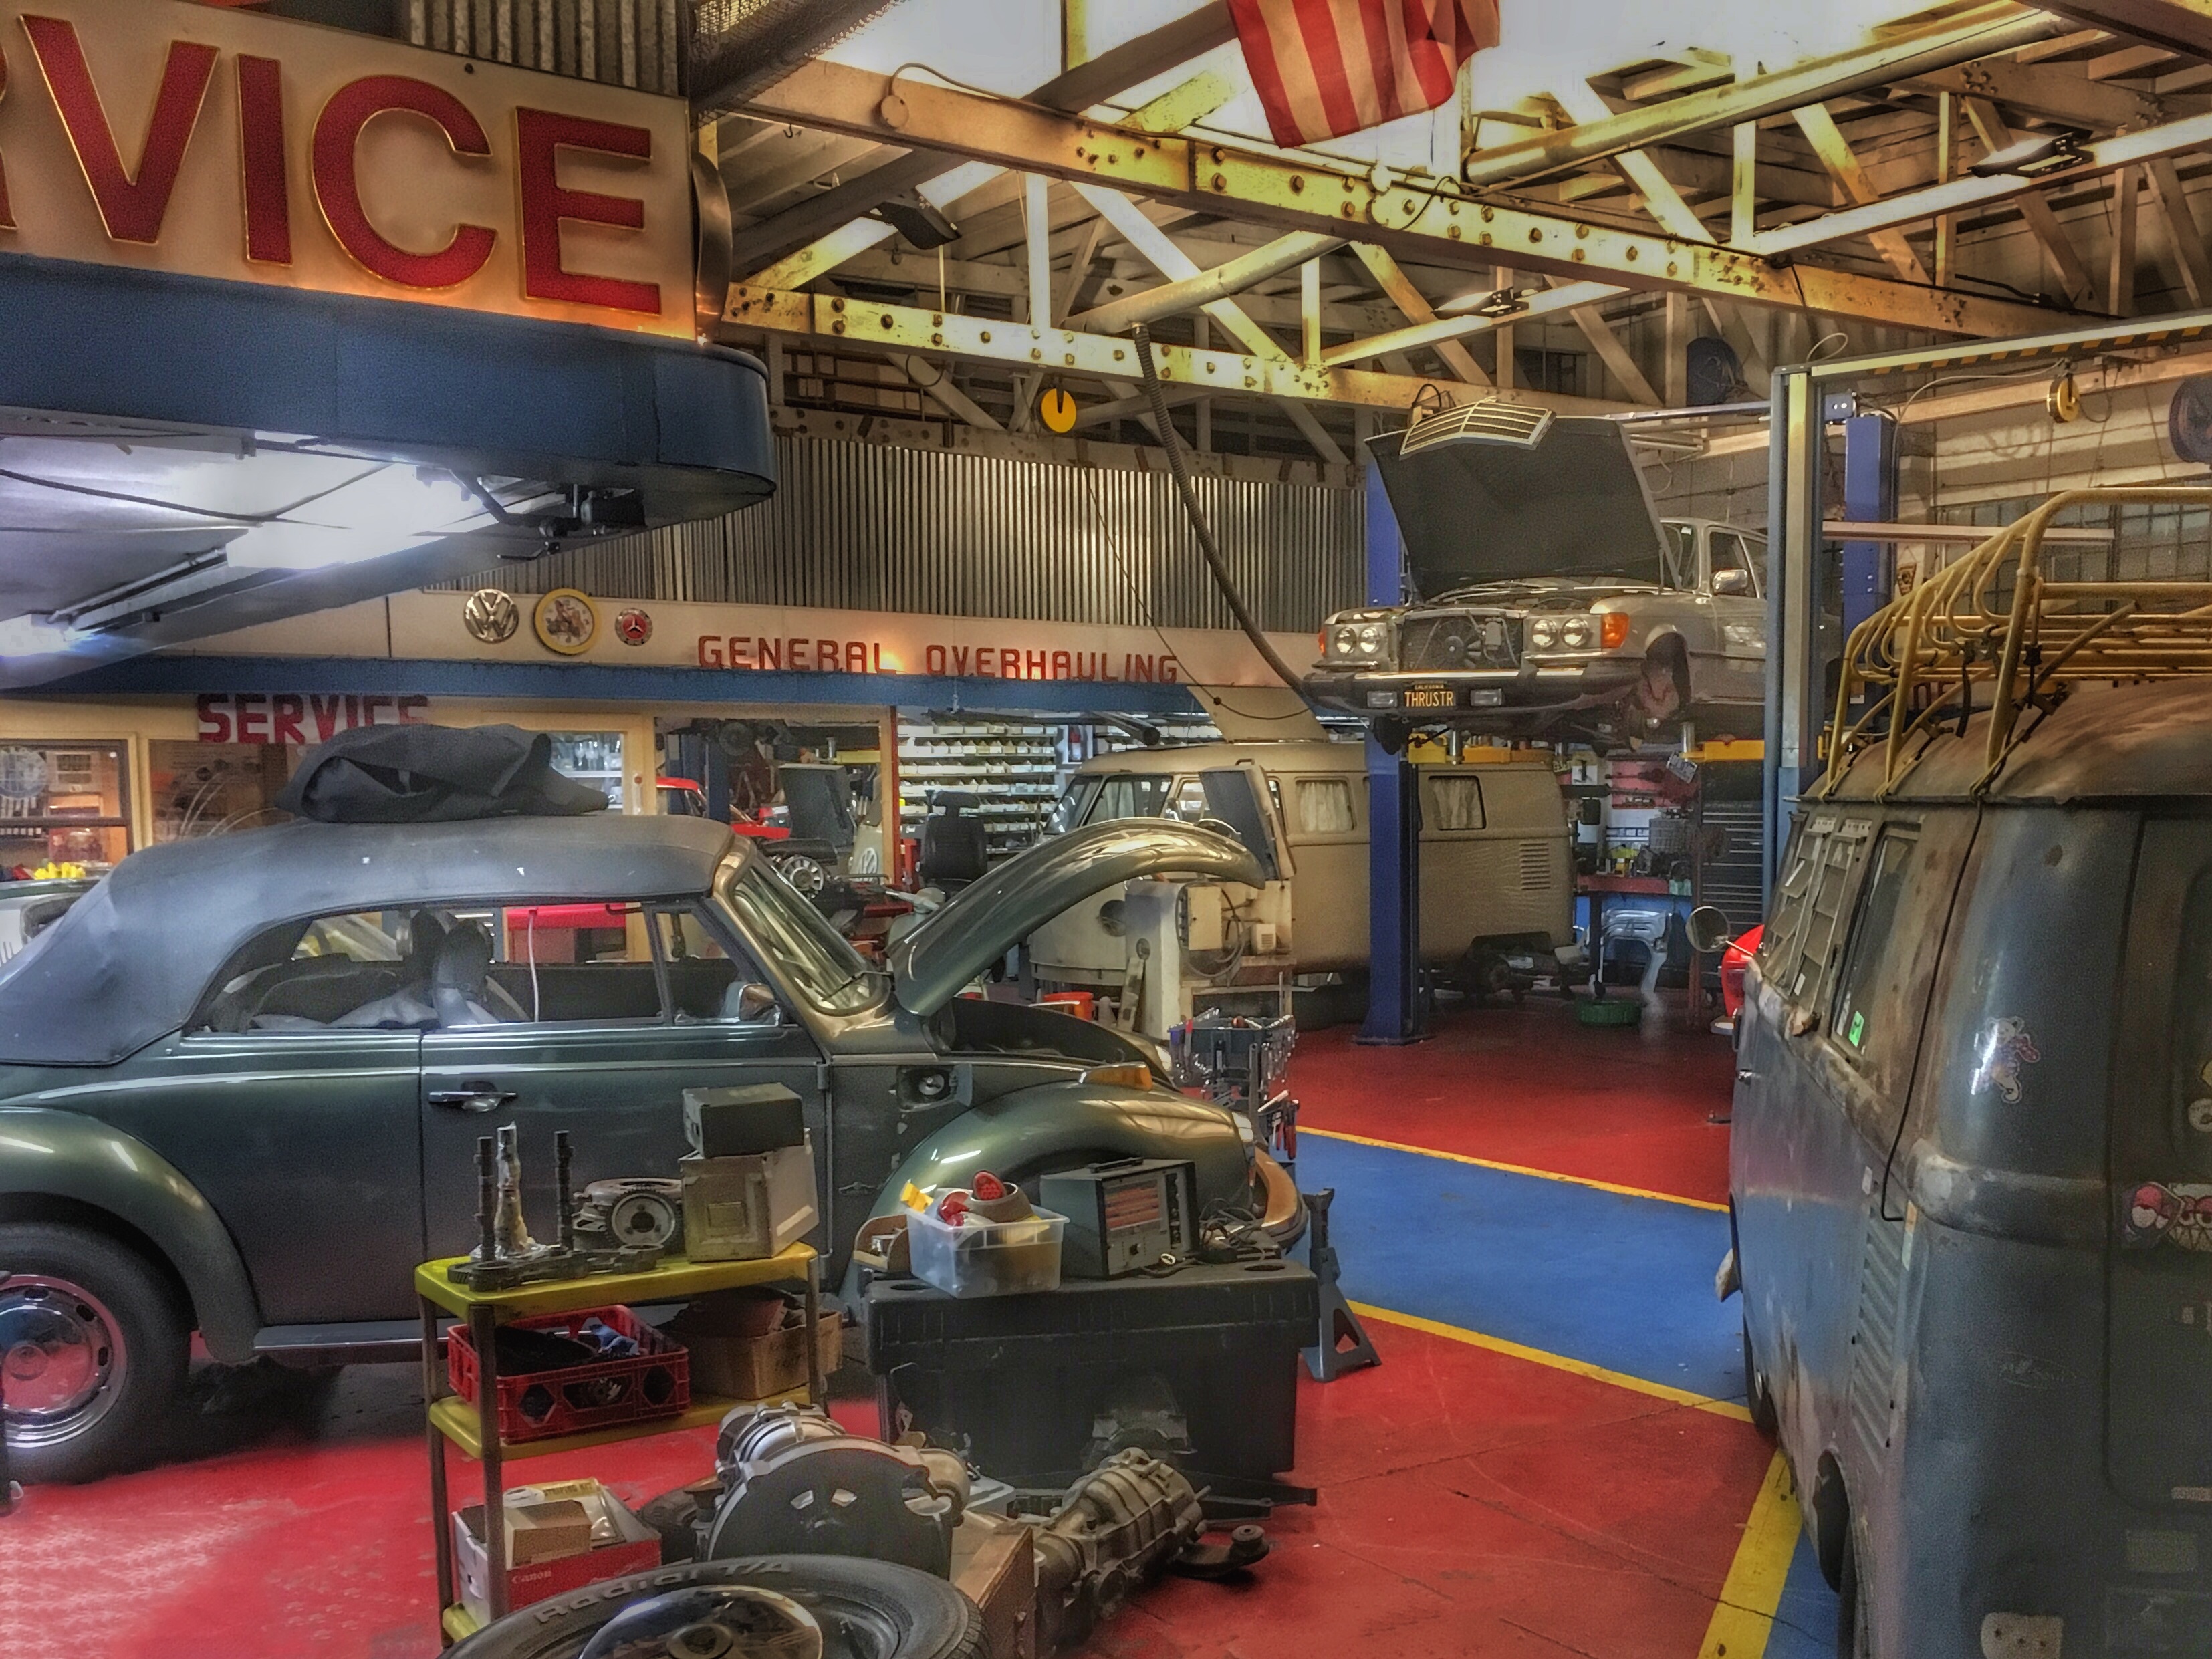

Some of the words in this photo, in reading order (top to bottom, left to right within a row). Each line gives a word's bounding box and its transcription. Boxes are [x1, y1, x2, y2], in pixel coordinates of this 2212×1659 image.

[0, 13, 662, 315] VICE
[698, 636, 898, 675] GENERAL
[926, 644, 1177, 684] OVERHAULING
[1404, 691, 1453, 707] THRUSTR
[511, 1569, 551, 1584] Canon
[535, 1568, 700, 1624] Radial
[719, 1560, 791, 1577] T/A
